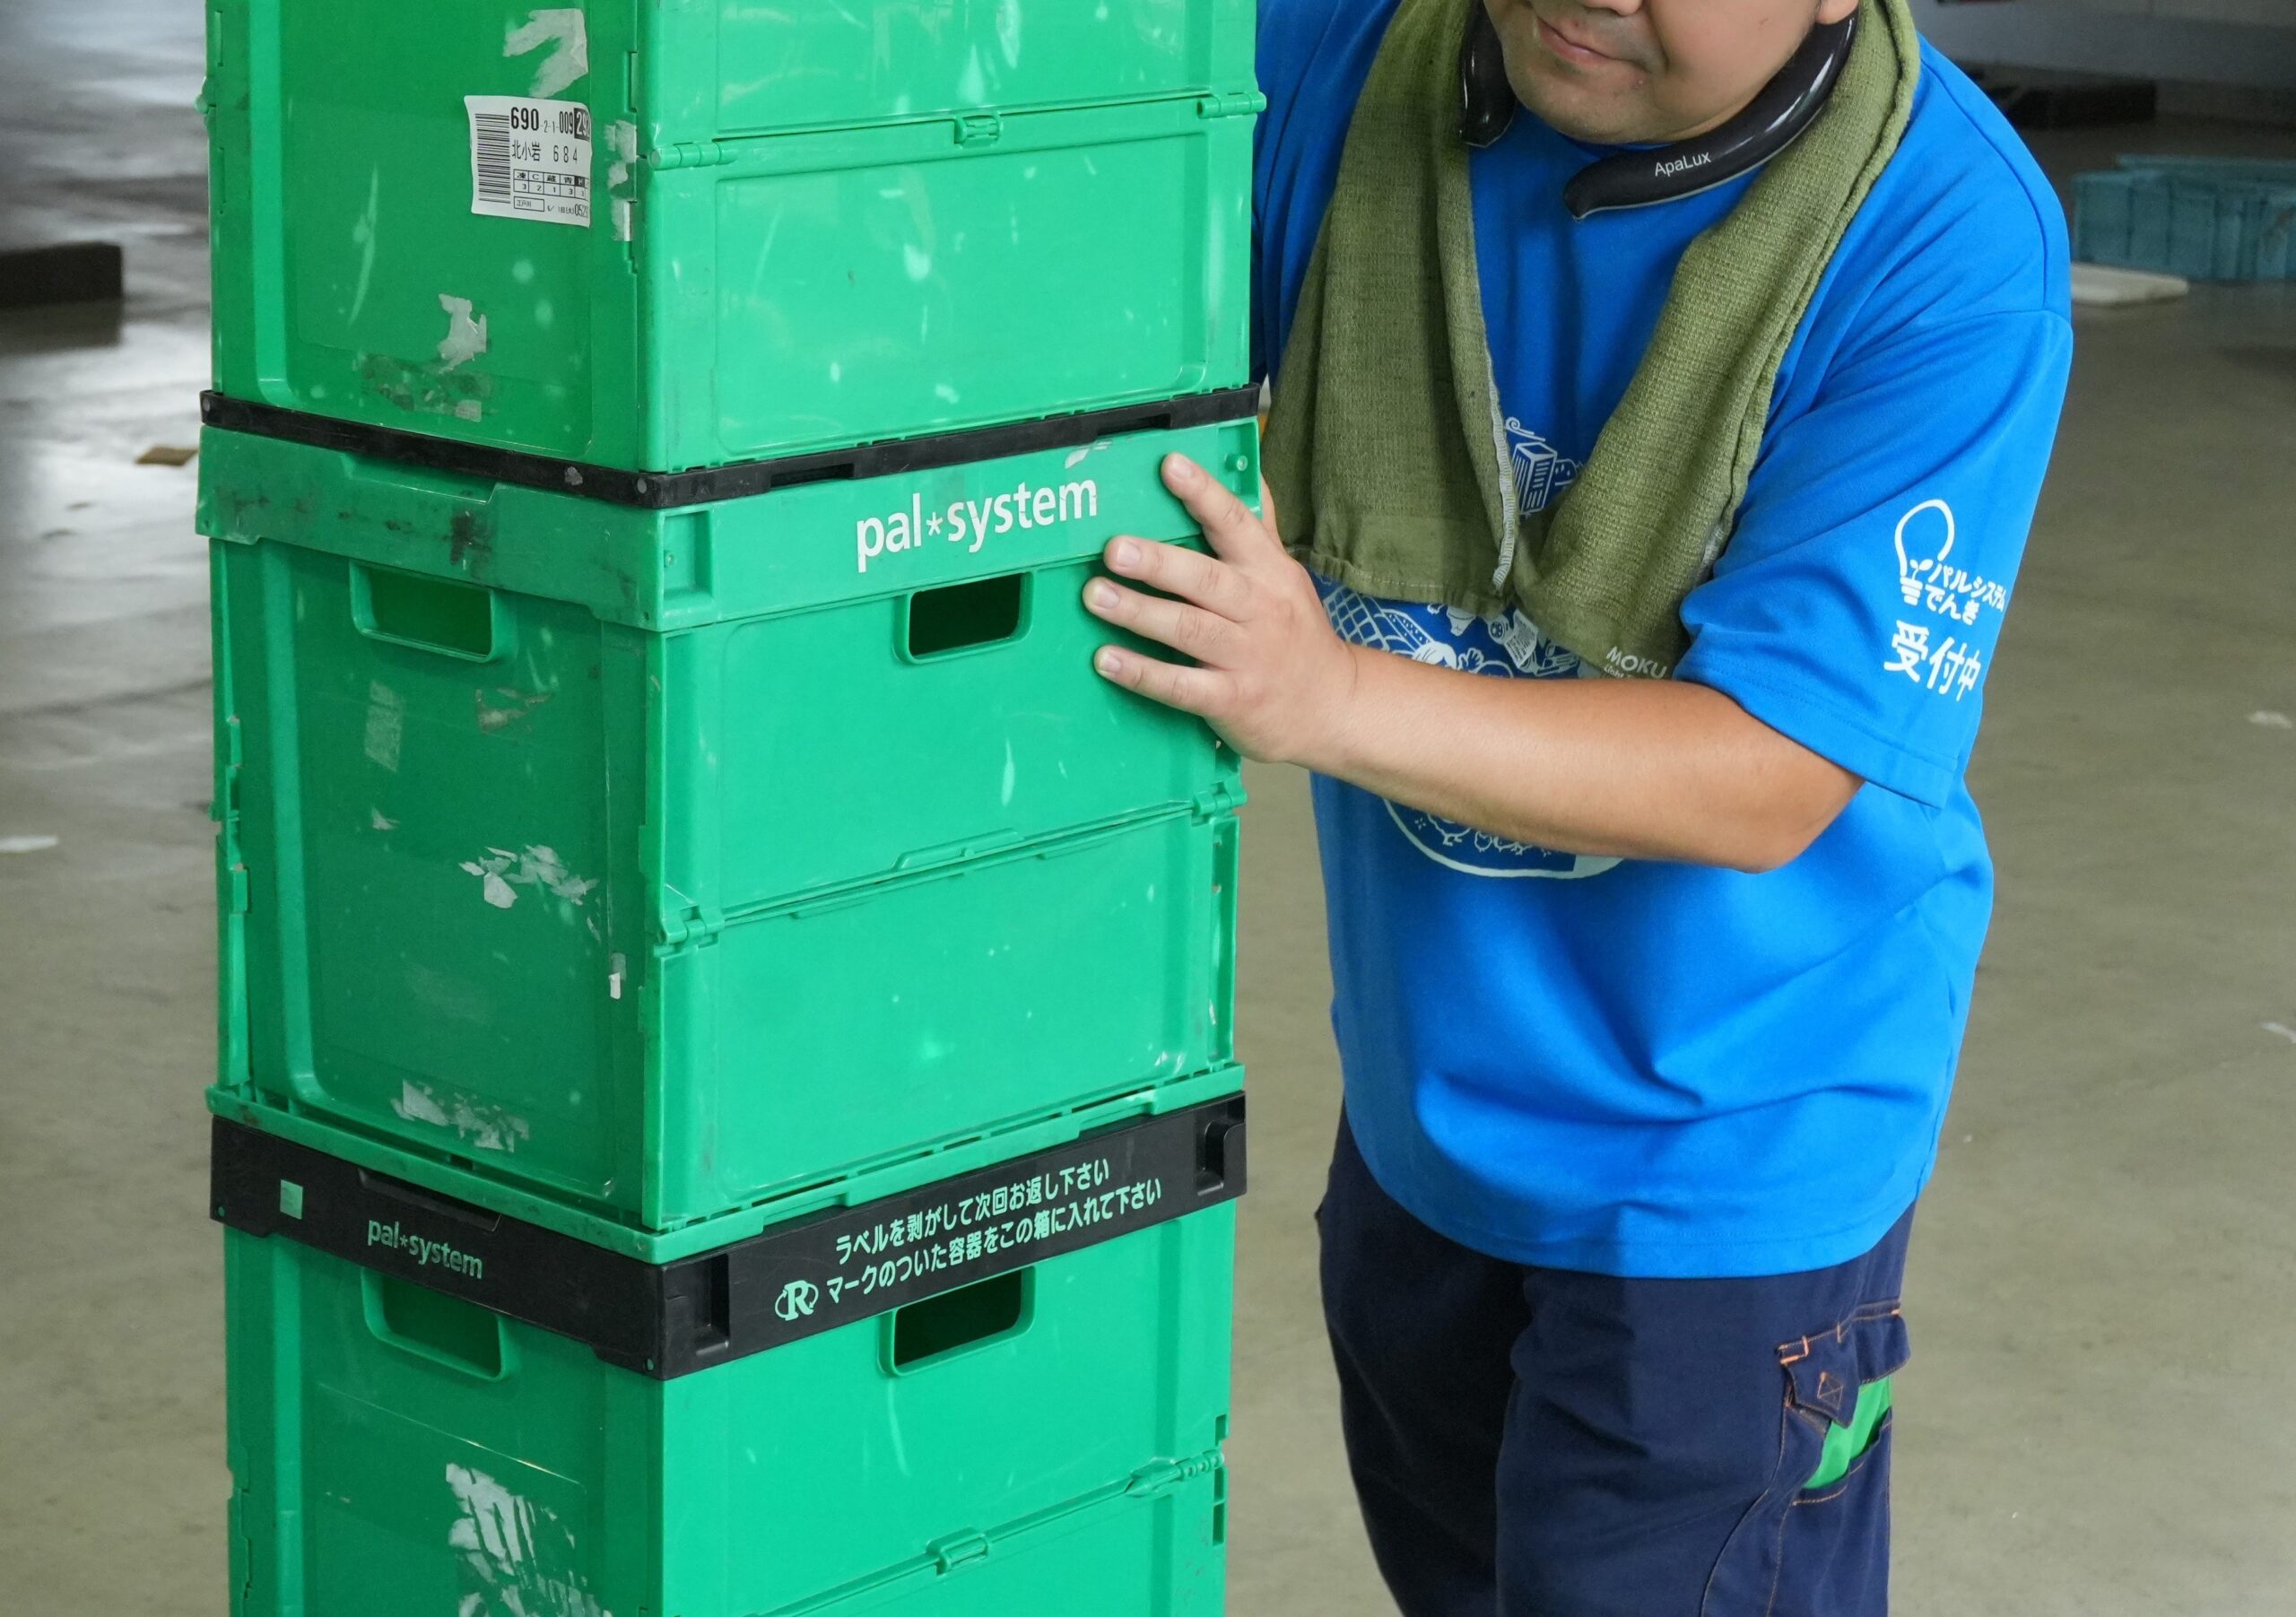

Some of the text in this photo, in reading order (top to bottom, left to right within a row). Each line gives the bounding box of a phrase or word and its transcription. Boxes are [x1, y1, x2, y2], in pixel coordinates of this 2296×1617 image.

[511, 139, 541, 162] 北小岩
[1655, 152, 1712, 178] ApaLux
[1925, 583, 1980, 626] でんき
[1927, 562, 2007, 613] パルシステム
[1605, 646, 1668, 680] MOKU
[1883, 619, 1982, 702] 受付中
[836, 1158, 1110, 1265] ラベルを剥がして次回お返し下さい
